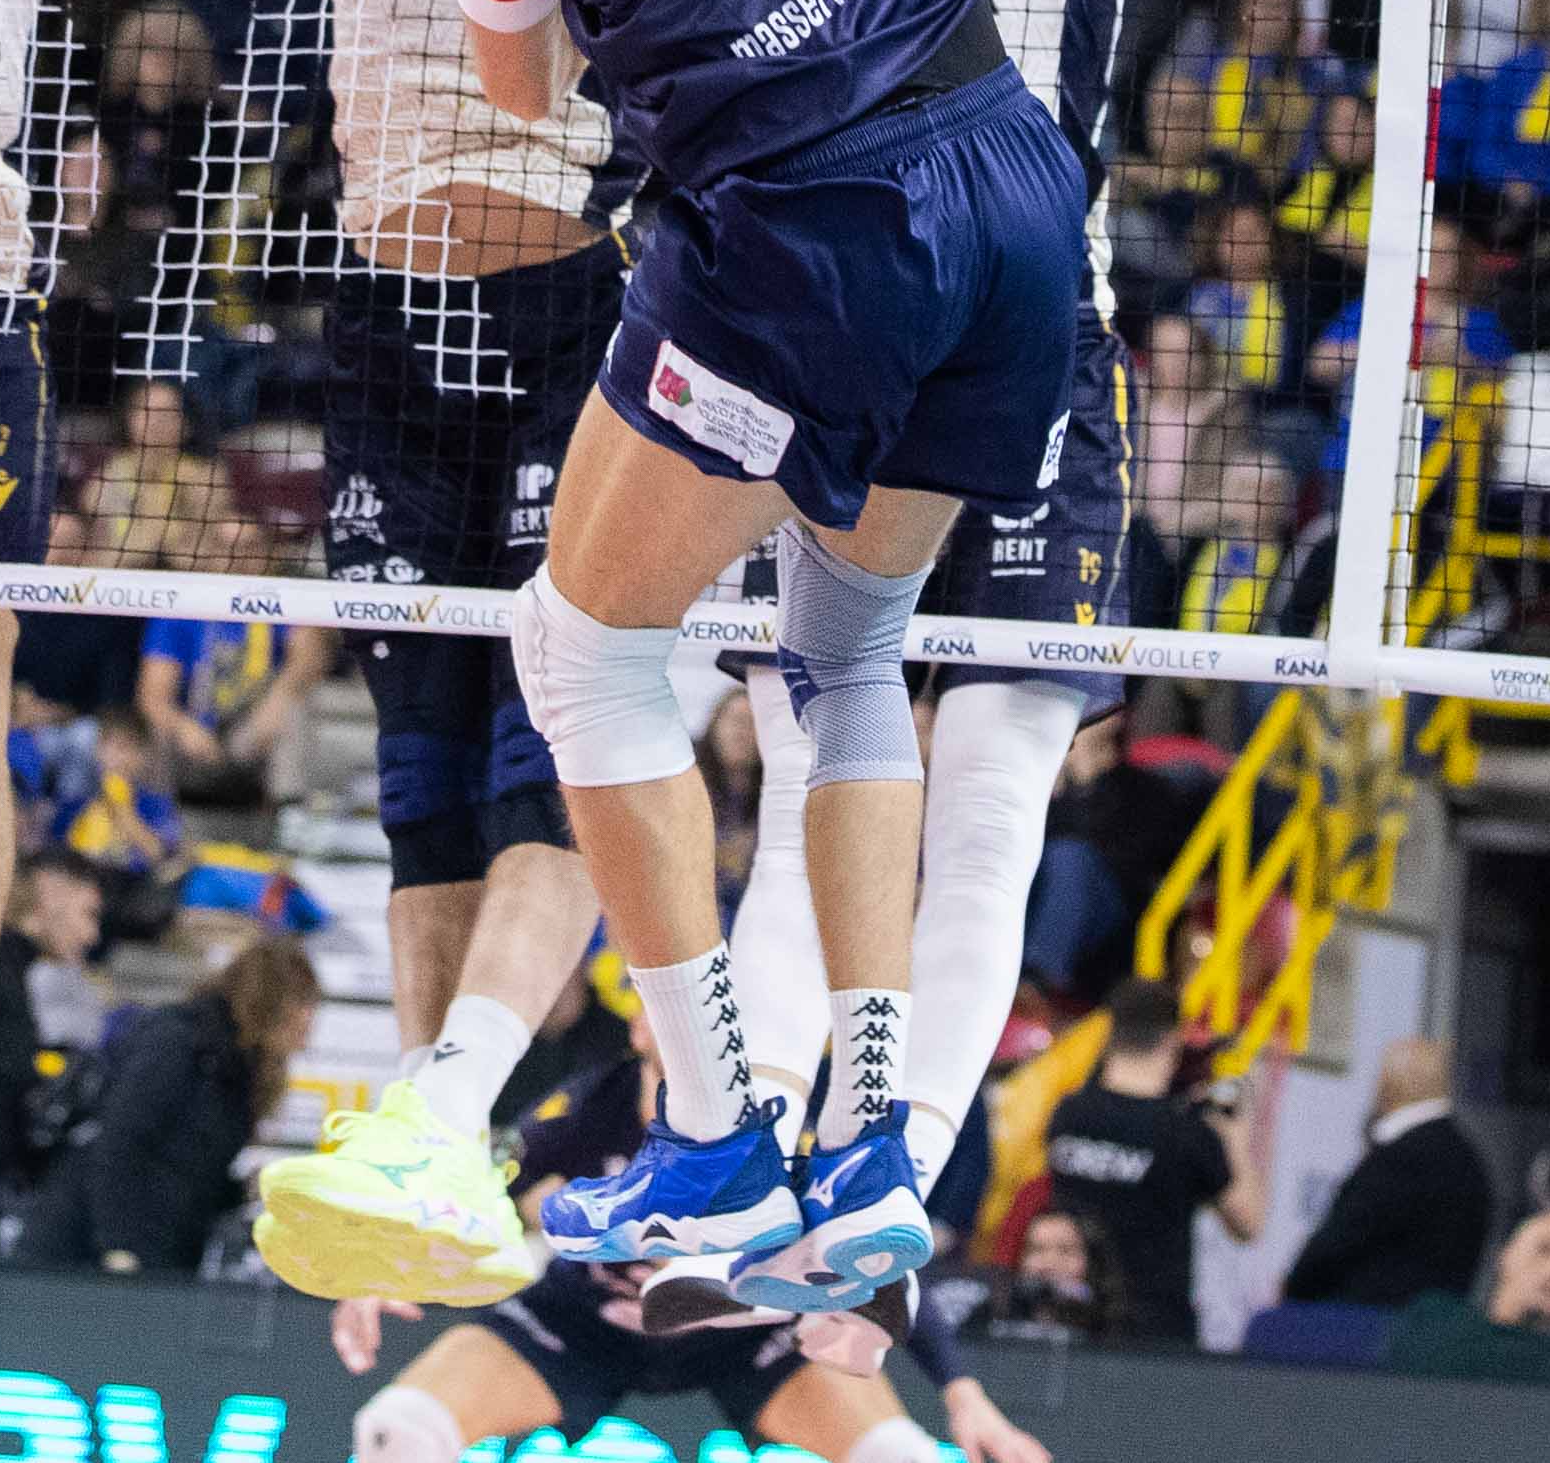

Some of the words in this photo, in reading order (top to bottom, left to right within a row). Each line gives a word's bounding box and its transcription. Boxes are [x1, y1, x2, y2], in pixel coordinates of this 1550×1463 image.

[992, 537, 1048, 563] RENT
[229, 594, 284, 618] RANA
[434, 606, 513, 631] VOLLE
[922, 635, 976, 658] RANA
[1274, 654, 1330, 681] RANA
